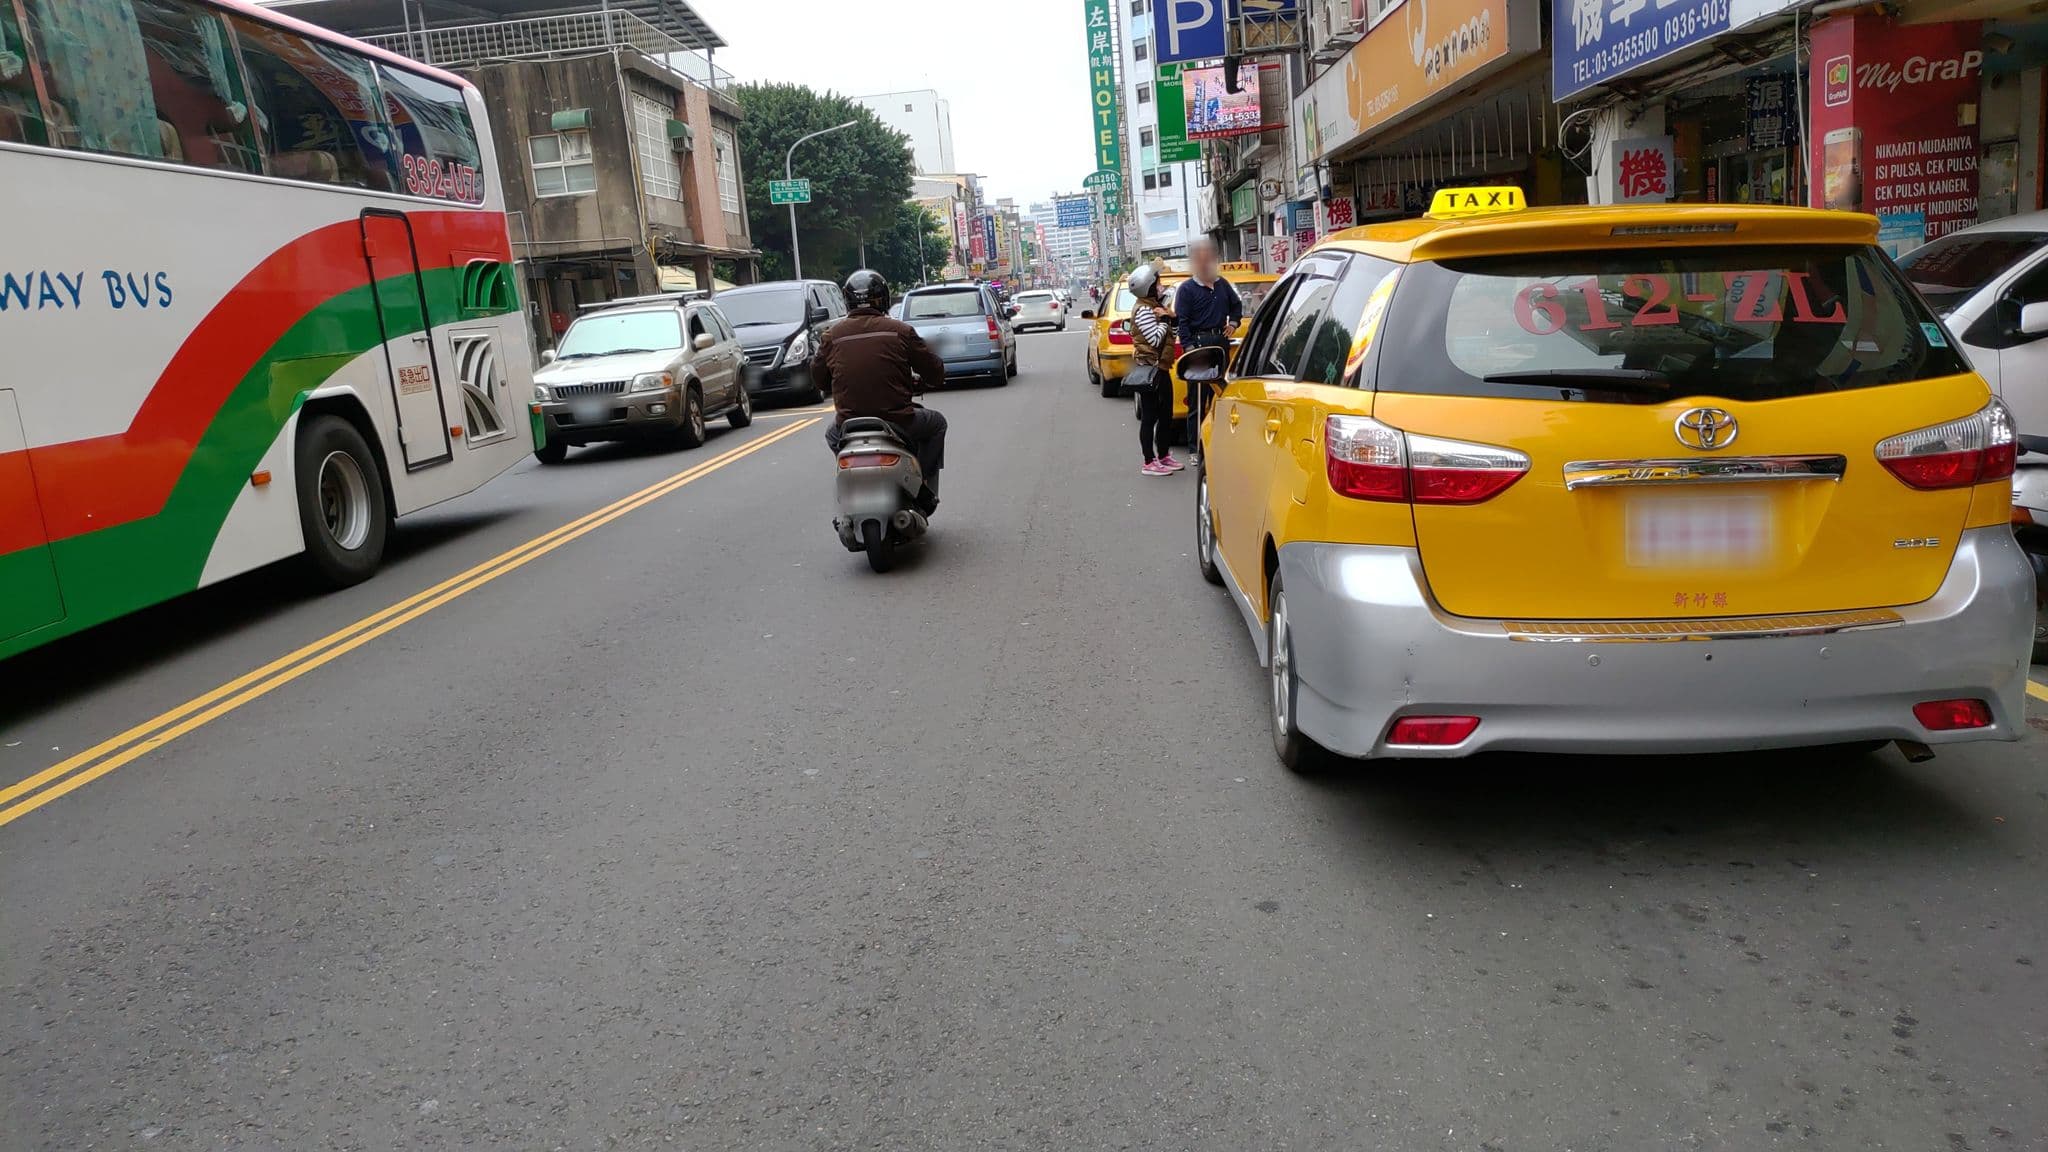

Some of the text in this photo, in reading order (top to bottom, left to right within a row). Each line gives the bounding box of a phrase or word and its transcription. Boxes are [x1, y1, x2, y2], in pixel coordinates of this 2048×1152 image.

[1095, 70, 1114, 165] HOTEL
[1875, 135, 1972, 160] NIKMATI MUDAHNYA
[403, 153, 476, 201] 332-U7
[1875, 165, 1888, 180] ISI
[1926, 159, 1945, 175] CEK
[1445, 191, 1514, 208] TAXI
[1875, 185, 1893, 201] CEK
[1895, 182, 1926, 199] PULSA
[1928, 197, 1978, 216] INDONESIA
[1223, 263, 1248, 271] TAXI
[101, 269, 172, 309] BUS
[1513, 271, 1848, 335] 612-ZL
